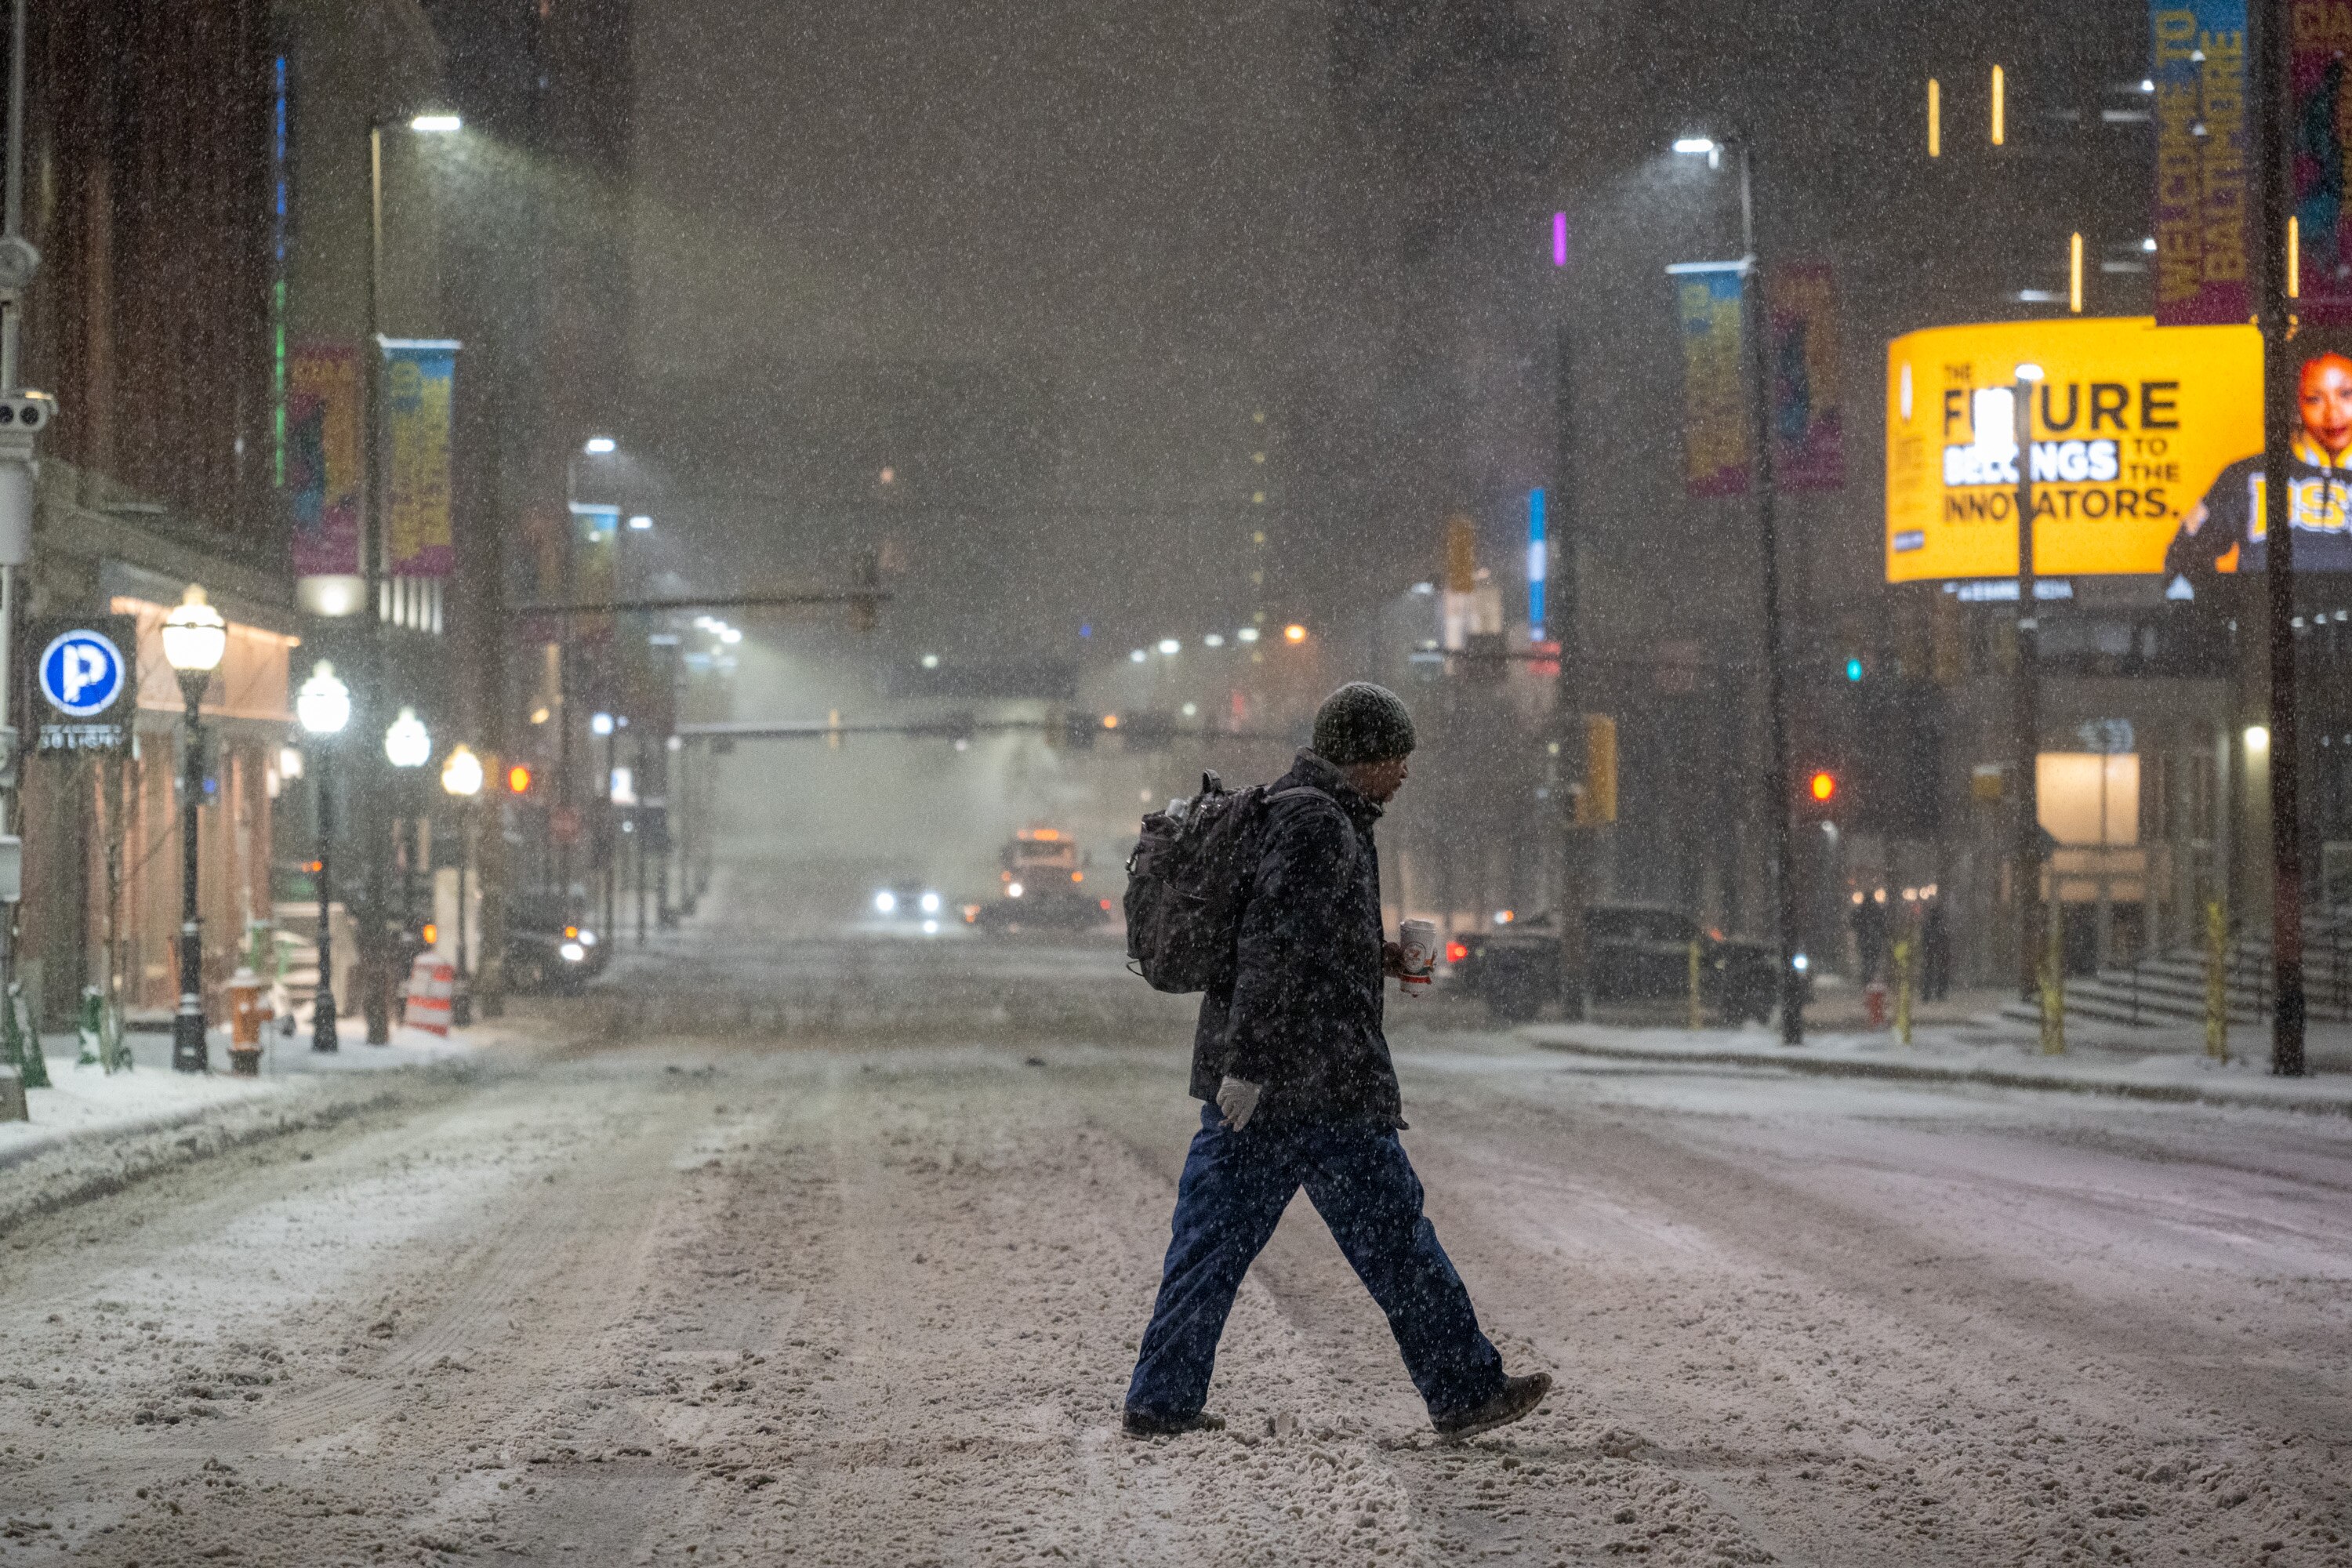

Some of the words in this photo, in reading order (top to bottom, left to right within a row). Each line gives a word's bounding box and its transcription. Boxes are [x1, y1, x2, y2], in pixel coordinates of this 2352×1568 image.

[2155, 9, 2196, 67] TO
[2201, 30, 2245, 281] BALTIMORE
[2158, 82, 2199, 303] WELCOME
[1944, 382, 2180, 436] FURE
[2130, 463, 2180, 483] THE
[2133, 438, 2168, 456] TO
